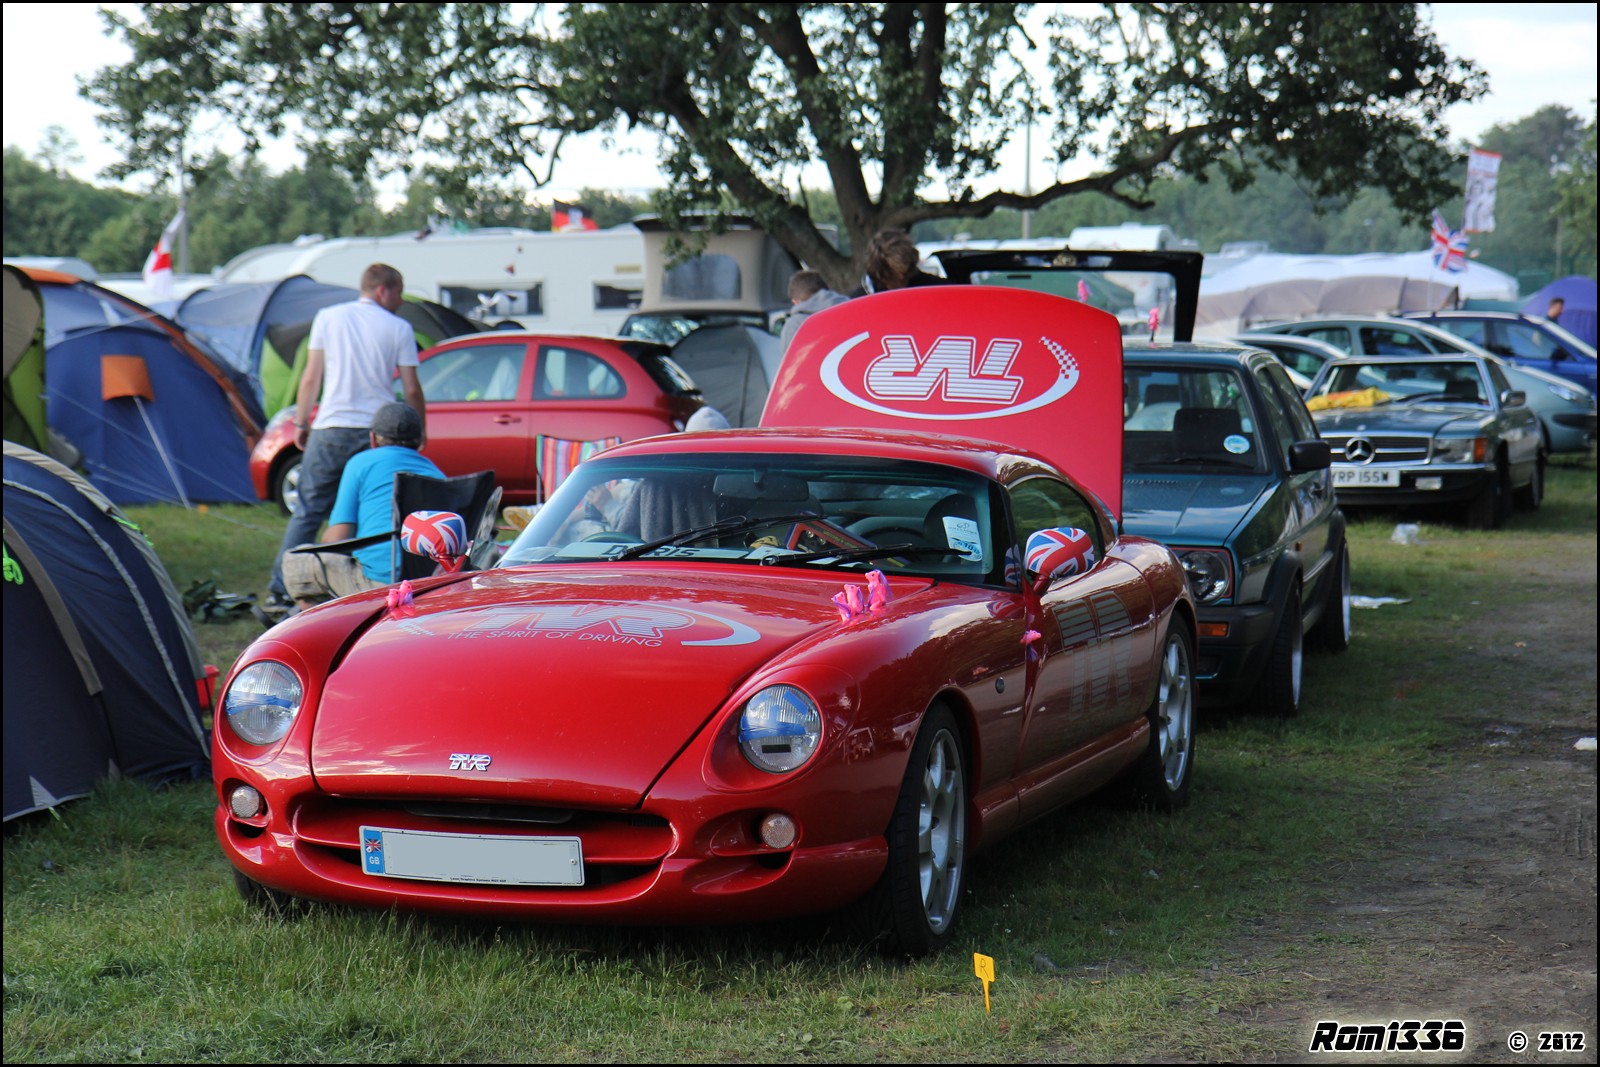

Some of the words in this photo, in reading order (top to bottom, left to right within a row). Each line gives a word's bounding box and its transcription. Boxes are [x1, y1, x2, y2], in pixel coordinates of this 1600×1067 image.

[864, 335, 1024, 404] TVR
[601, 545, 700, 557] DRIS
[463, 604, 696, 640] TVR
[447, 631, 482, 640] THE
[486, 630, 542, 639] SPIRIT
[545, 631, 575, 640] OF
[578, 632, 663, 648] DRIVING
[449, 753, 492, 771] TVR
[369, 856, 380, 865] GB
